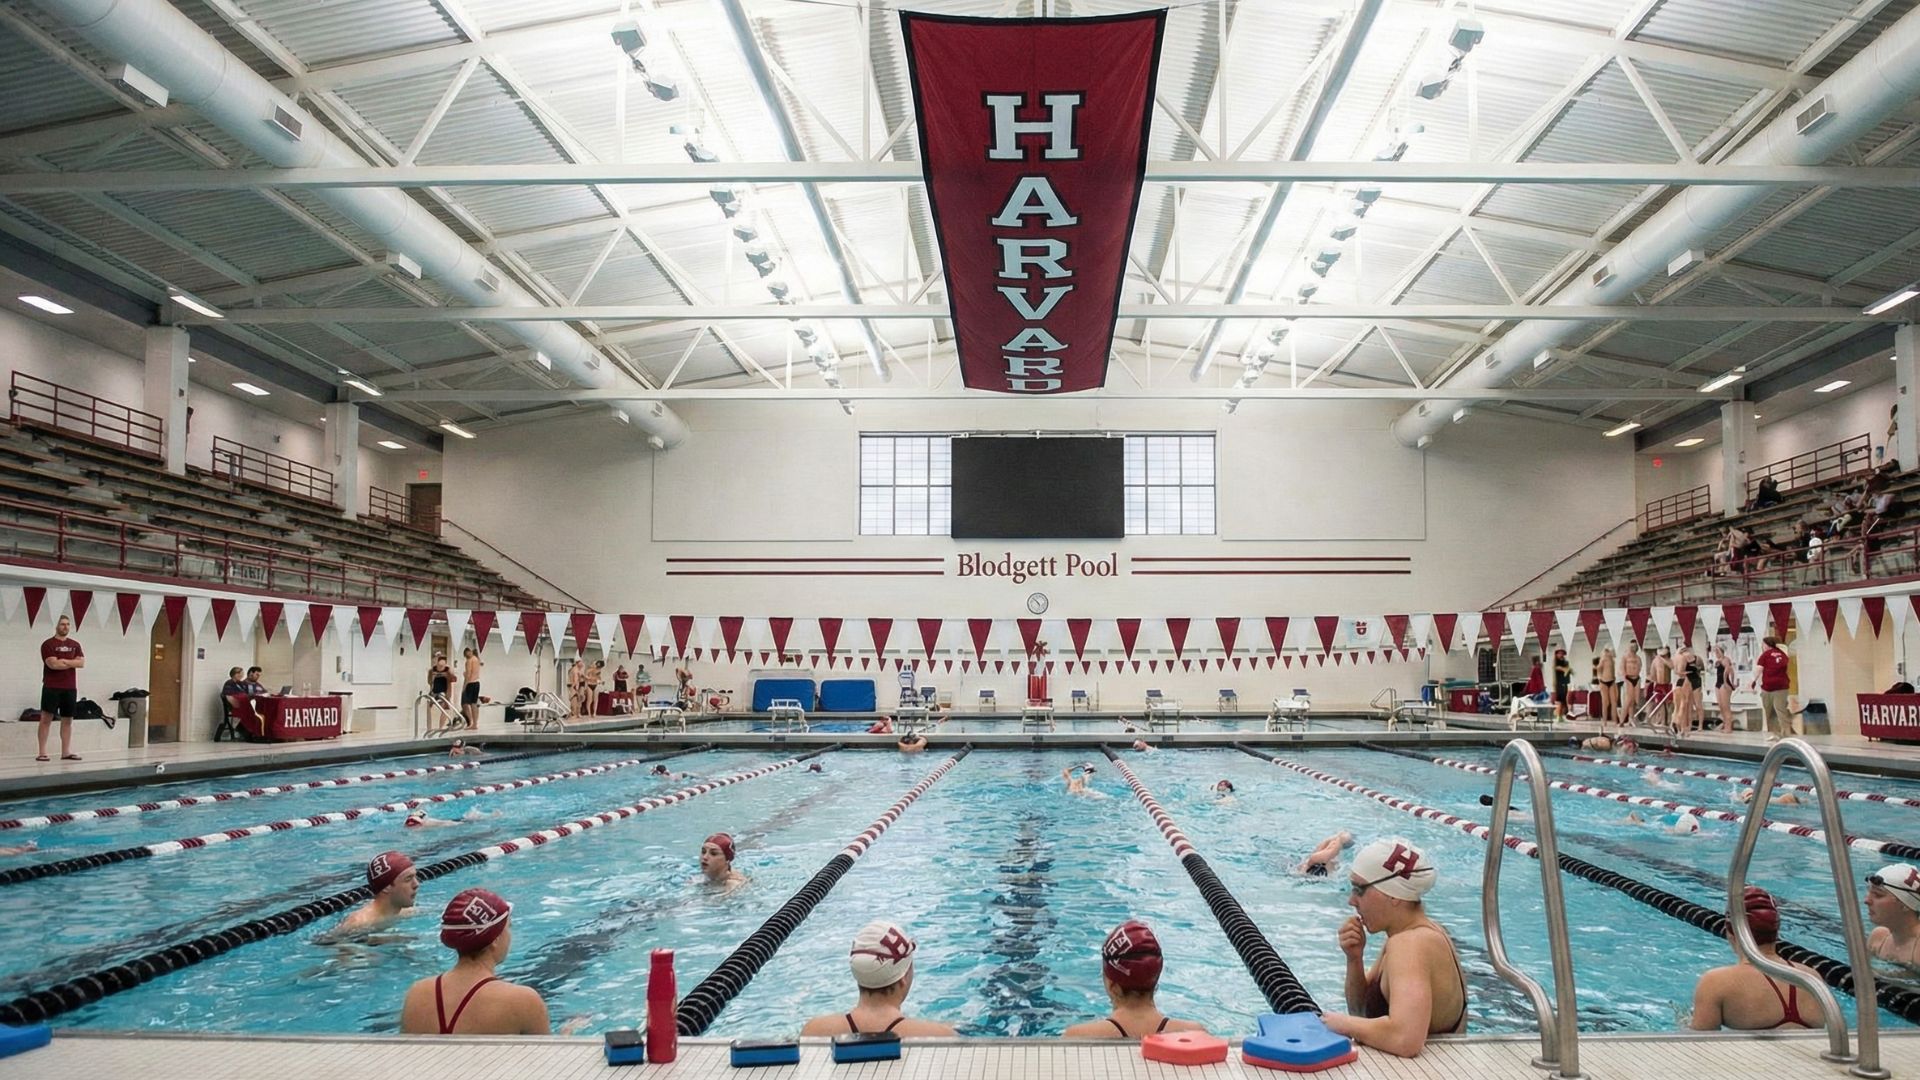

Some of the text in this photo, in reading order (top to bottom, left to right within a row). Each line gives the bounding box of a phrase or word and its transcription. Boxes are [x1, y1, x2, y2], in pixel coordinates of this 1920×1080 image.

[984, 92, 1083, 393] HARVARD
[957, 552, 1119, 584] Blodgett Pool
[284, 707, 338, 728] HARVARD
[1860, 703, 1920, 727] HARVAR
[1382, 843, 1420, 880] H
